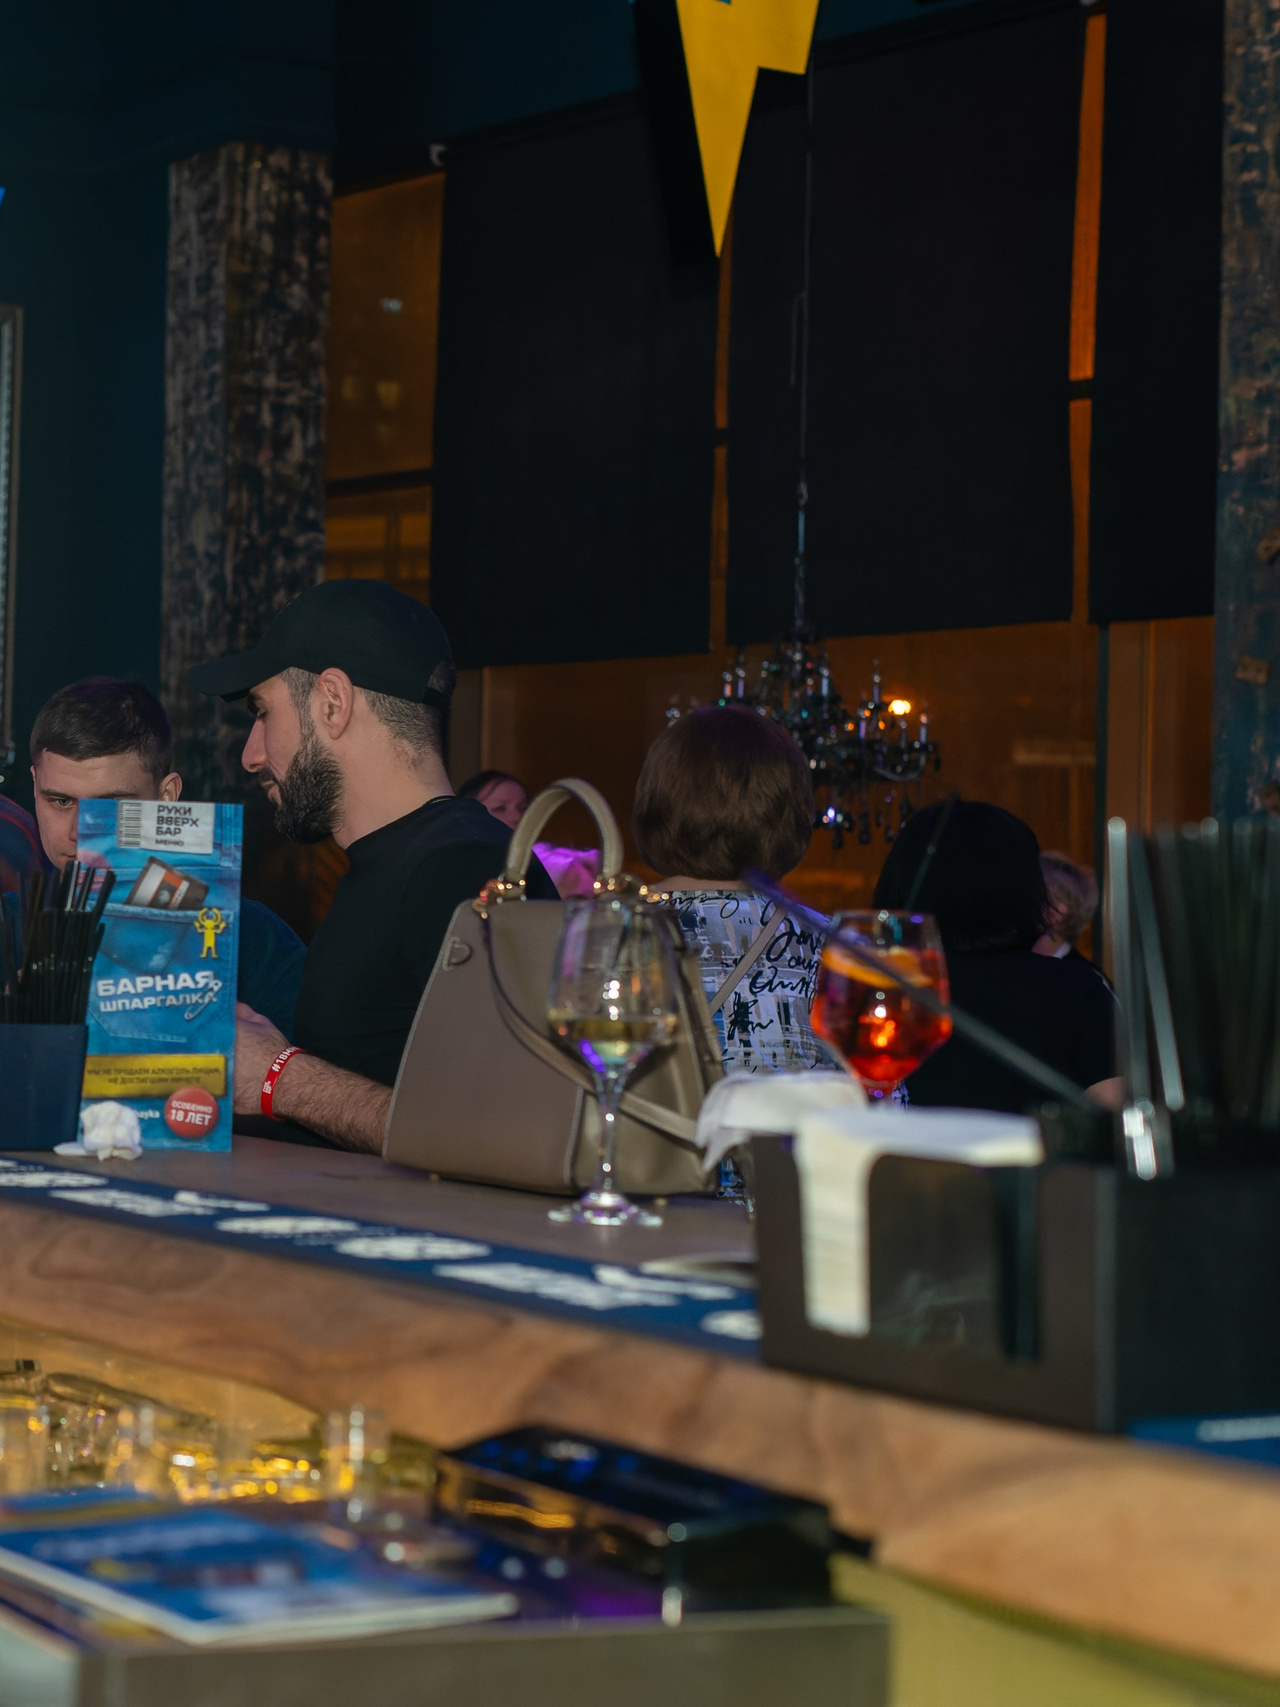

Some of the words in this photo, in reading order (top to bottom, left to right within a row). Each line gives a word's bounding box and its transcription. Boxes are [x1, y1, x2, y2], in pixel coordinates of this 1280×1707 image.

[157, 804, 192, 816] РУКИ
[156, 815, 200, 828] ВВЕРХ
[155, 826, 182, 836] БАР
[96, 970, 214, 997] БАРНАЯ
[99, 989, 218, 1013] ШПАРГАЛКА
[170, 1109, 184, 1122] 18
[185, 1112, 212, 1126] ЛЕТ
